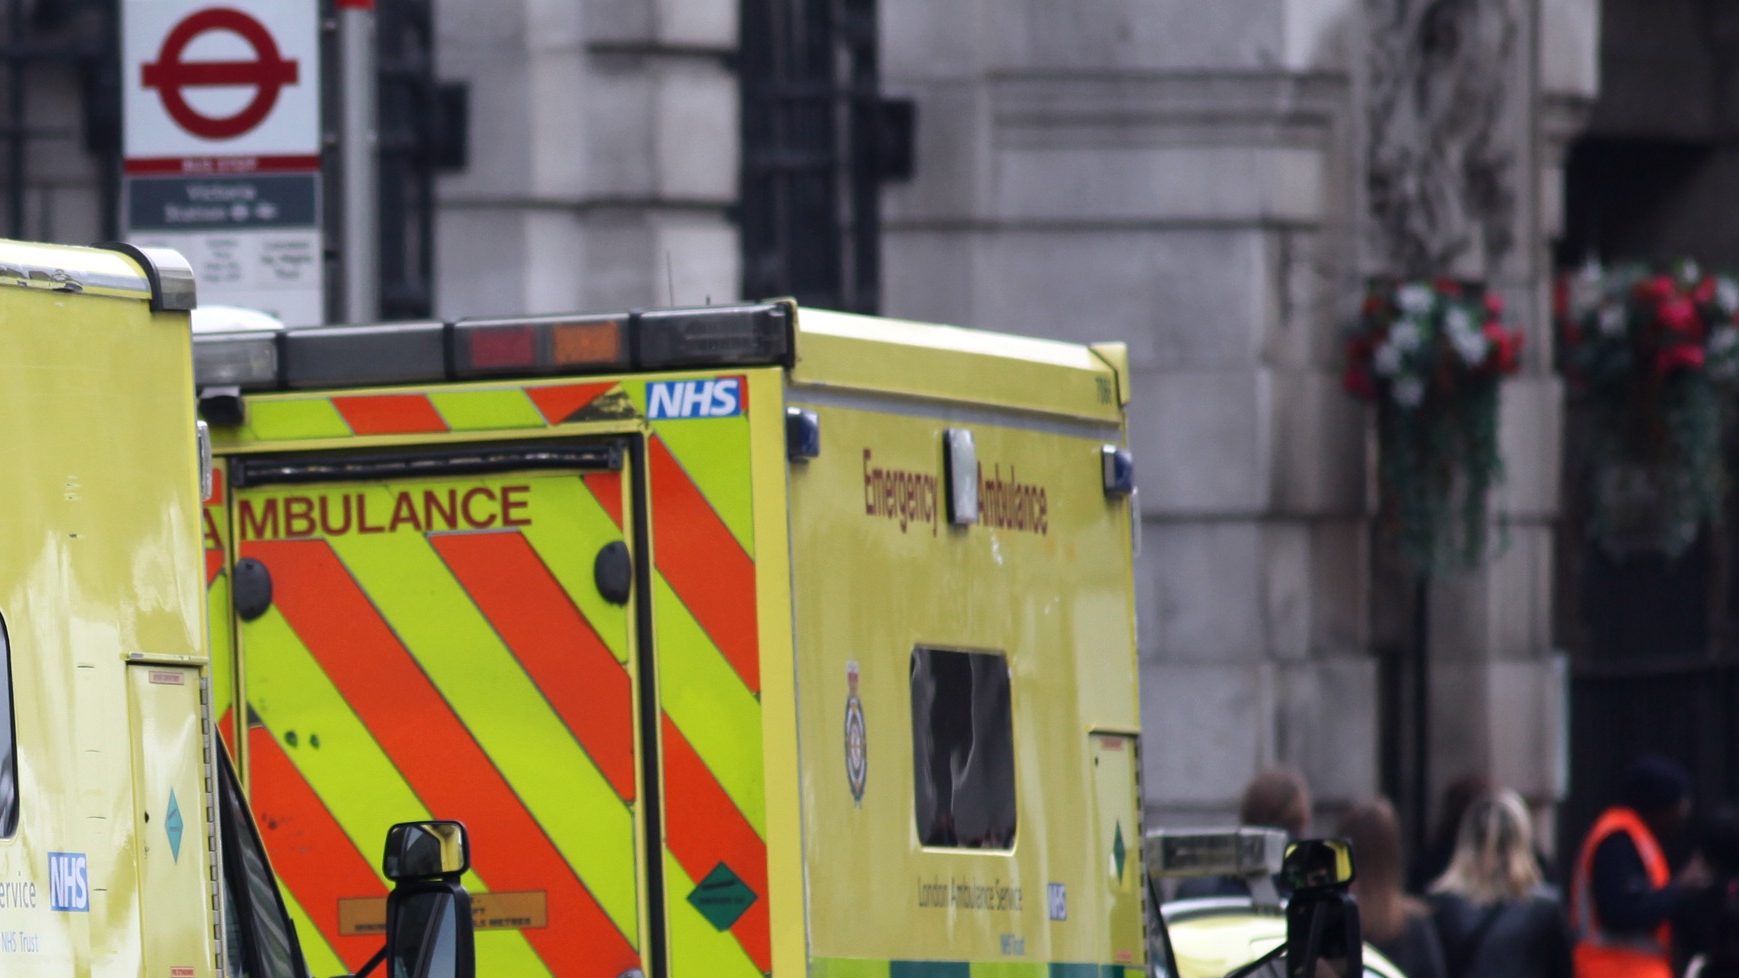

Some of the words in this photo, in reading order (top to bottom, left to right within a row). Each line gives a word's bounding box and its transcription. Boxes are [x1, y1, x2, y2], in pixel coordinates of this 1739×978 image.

[648, 379, 738, 419] NHS
[863, 448, 938, 538] Emergency
[50, 856, 87, 910] NHS
[2, 931, 17, 953] NHS
[19, 931, 39, 953] Trust
